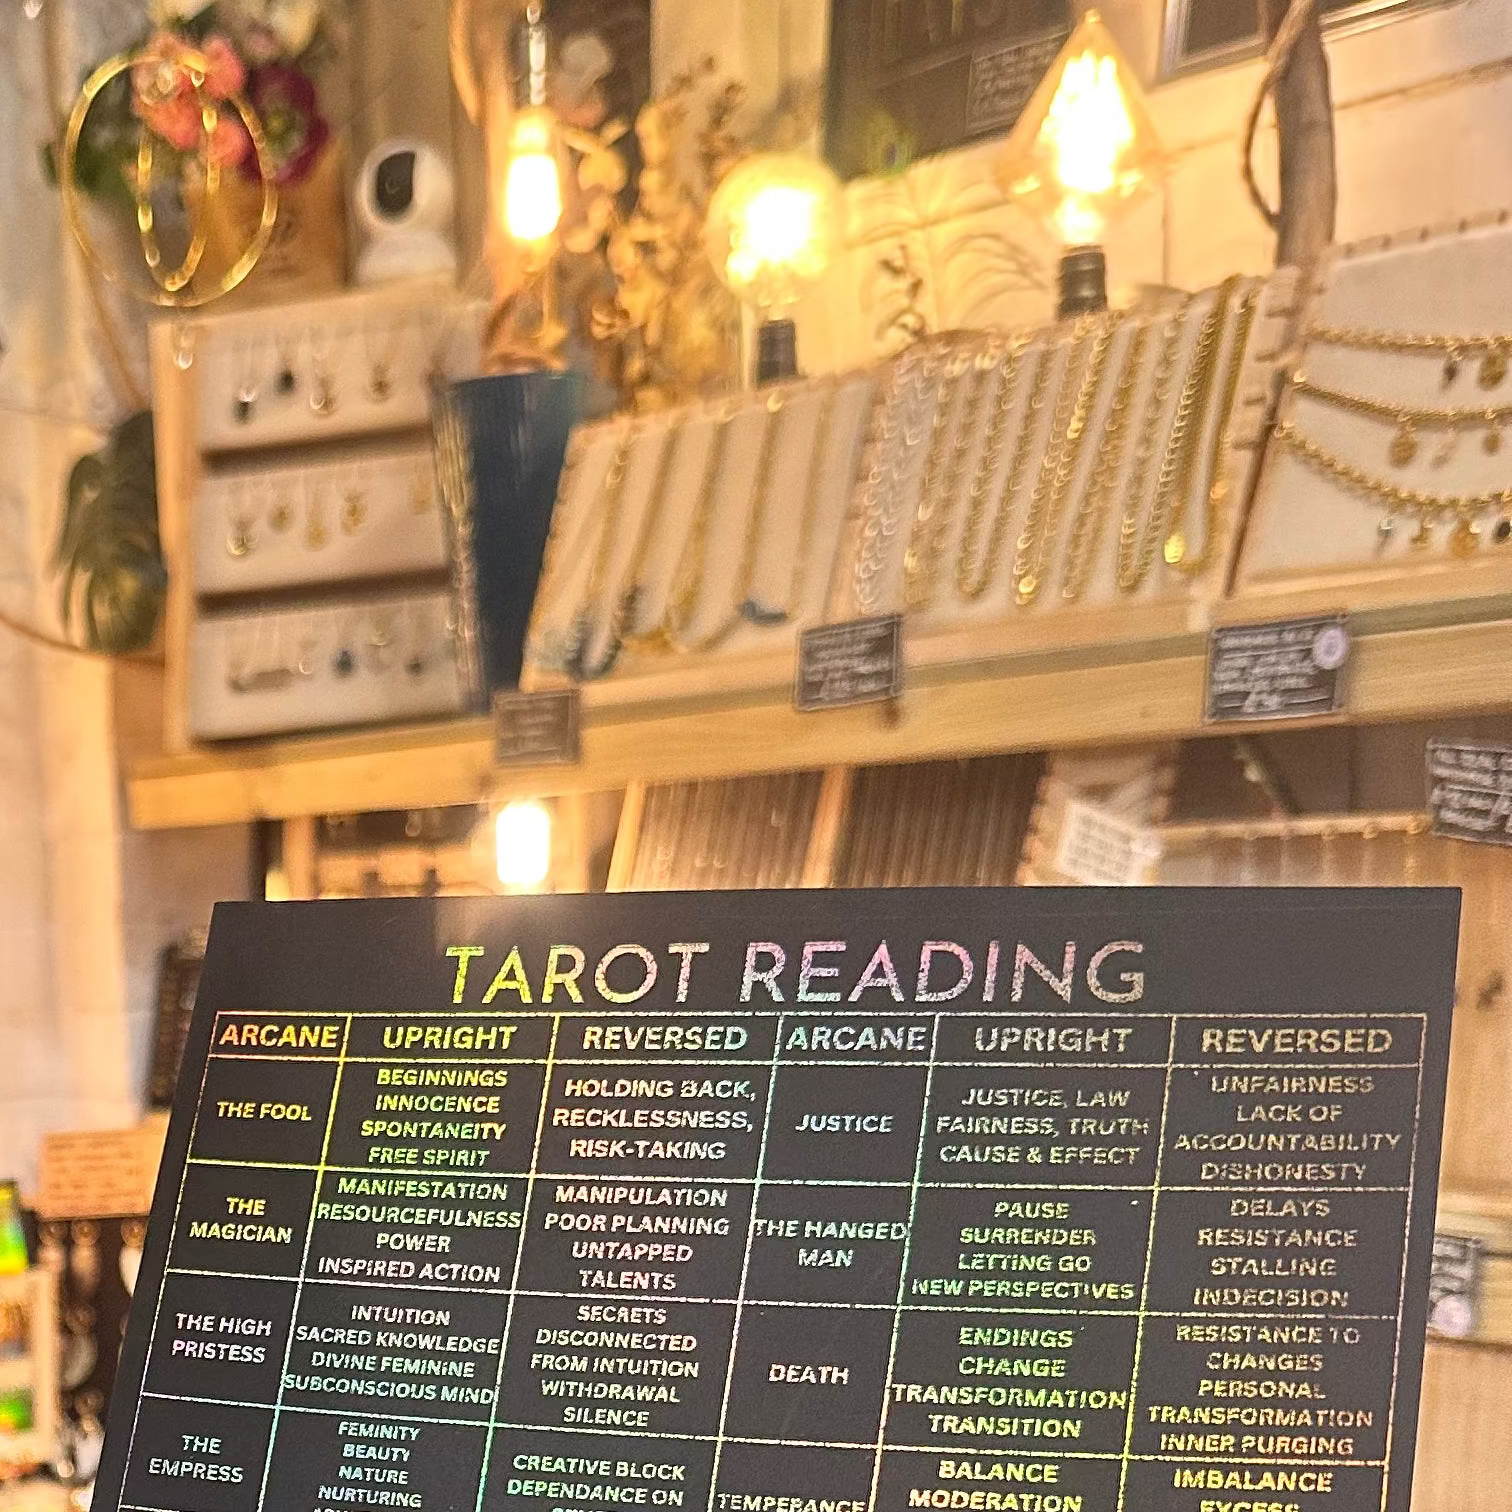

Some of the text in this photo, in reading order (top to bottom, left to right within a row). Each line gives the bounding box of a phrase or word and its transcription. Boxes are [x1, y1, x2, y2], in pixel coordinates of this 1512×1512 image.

[445, 939, 1144, 1003] TAROT READING
[218, 1024, 339, 1047] ARCANE
[383, 1025, 517, 1048] UPRIGHT
[582, 1025, 747, 1049] REVERSED
[785, 1026, 926, 1050] ARCANE
[975, 1027, 1132, 1051] UPRIGHT
[1201, 1028, 1392, 1052] REVERSED
[377, 1068, 507, 1086] BEGINNINGS
[216, 1101, 311, 1120] THE FOOL
[795, 1114, 893, 1132] JUSTICE
[569, 1138, 725, 1159] RISK-TAKING
[939, 1145, 1139, 1164] CAUSE & EFFECT
[226, 1197, 265, 1215] THE
[555, 1185, 727, 1206] MANIPULATION
[798, 1248, 854, 1266] MAN
[318, 1256, 500, 1282] INSPIRED ACTION
[912, 1279, 1134, 1298] NEW PERSPECTIVES
[351, 1305, 450, 1325] INTUITION
[536, 1328, 697, 1350] DISCONNECTED
[171, 1339, 265, 1362] PRISTESS
[769, 1363, 848, 1384] DEATH
[928, 1414, 1081, 1437] TRANSITION
[1147, 1405, 1372, 1426] TRANSFORMATION
[342, 1443, 409, 1461] BEAUTY
[149, 1458, 243, 1482] EMPRESS
[938, 1460, 1059, 1482] BALANCE
